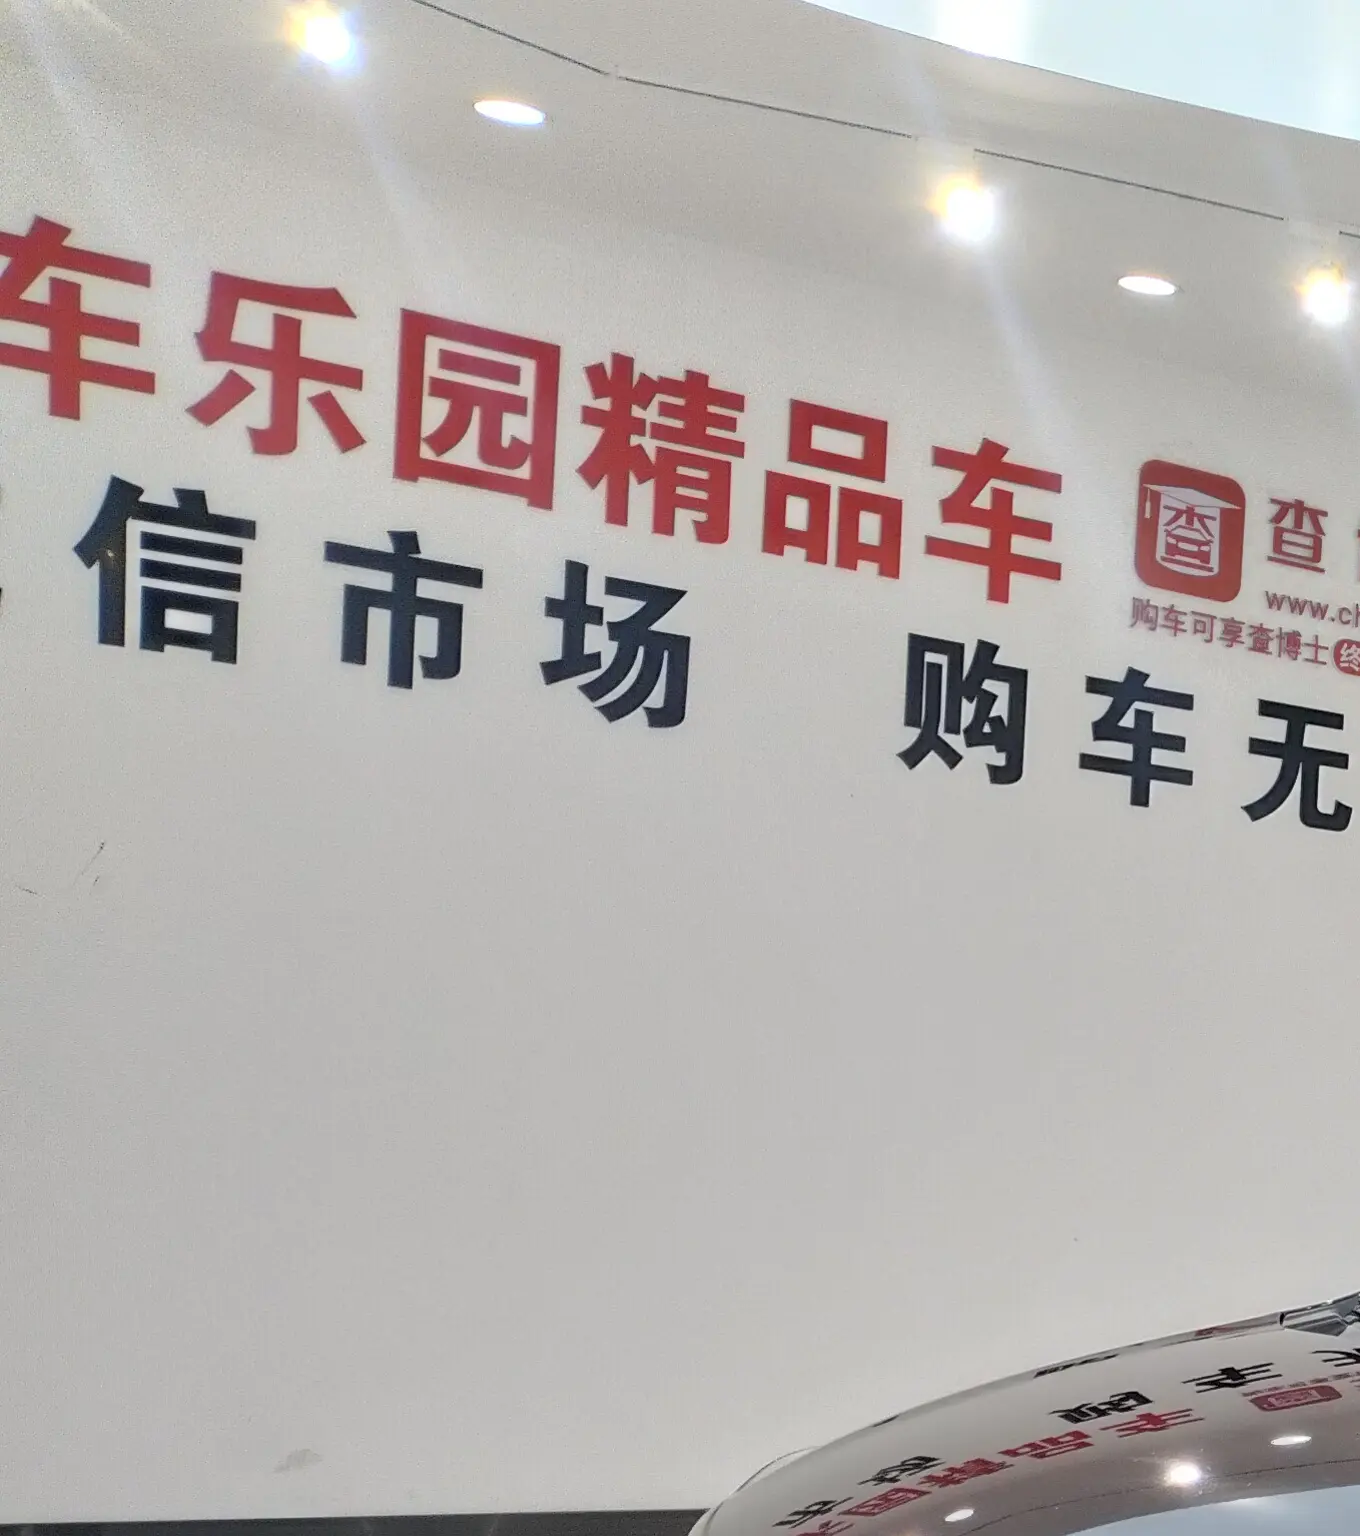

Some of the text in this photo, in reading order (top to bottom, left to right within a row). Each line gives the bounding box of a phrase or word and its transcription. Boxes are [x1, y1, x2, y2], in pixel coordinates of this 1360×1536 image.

[0, 215, 1064, 606] 车乐园精品车
